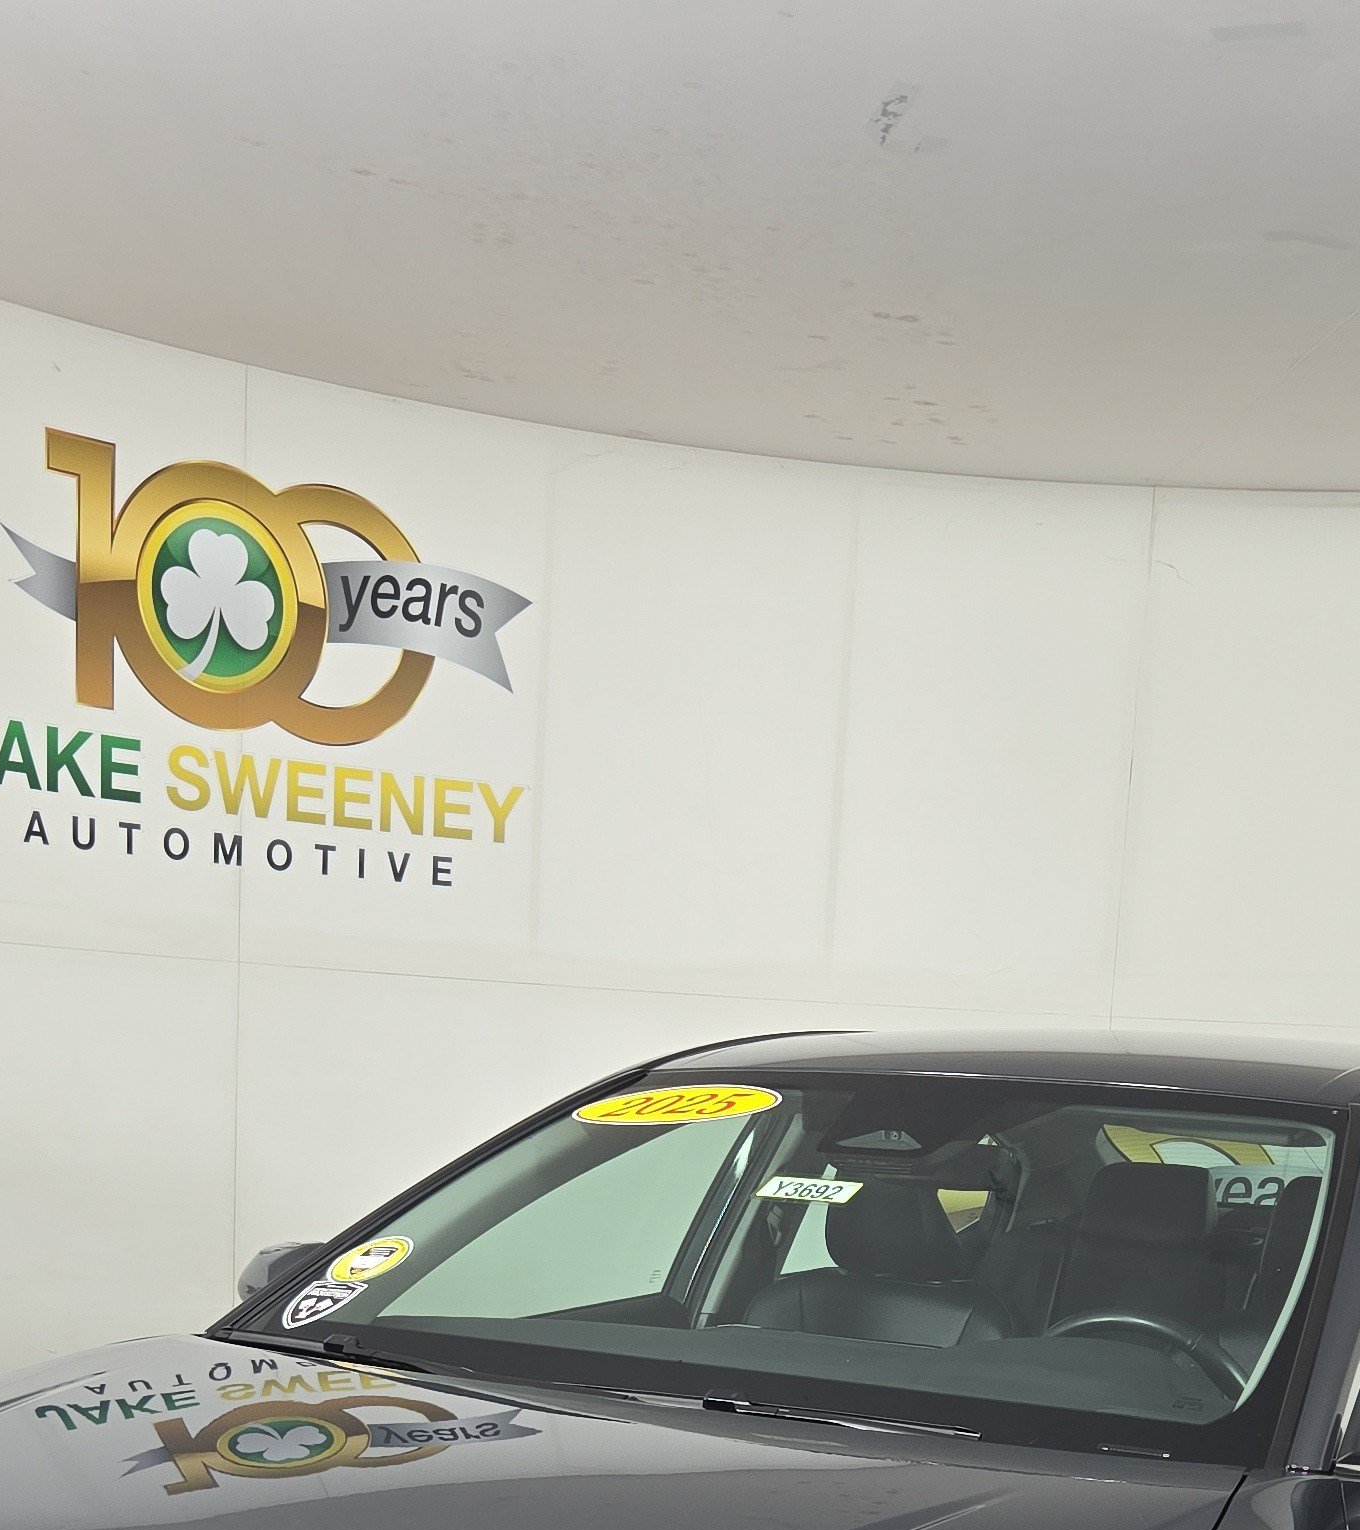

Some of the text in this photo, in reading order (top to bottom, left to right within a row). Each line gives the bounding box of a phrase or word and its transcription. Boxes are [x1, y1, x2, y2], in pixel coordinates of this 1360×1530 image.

[44, 427, 485, 746] 100 years
[166, 744, 525, 844] SWEENEY
[23, 810, 453, 887] AUTOMOTIVE
[598, 1093, 755, 1118] 2025
[771, 1181, 844, 1200] Y3692
